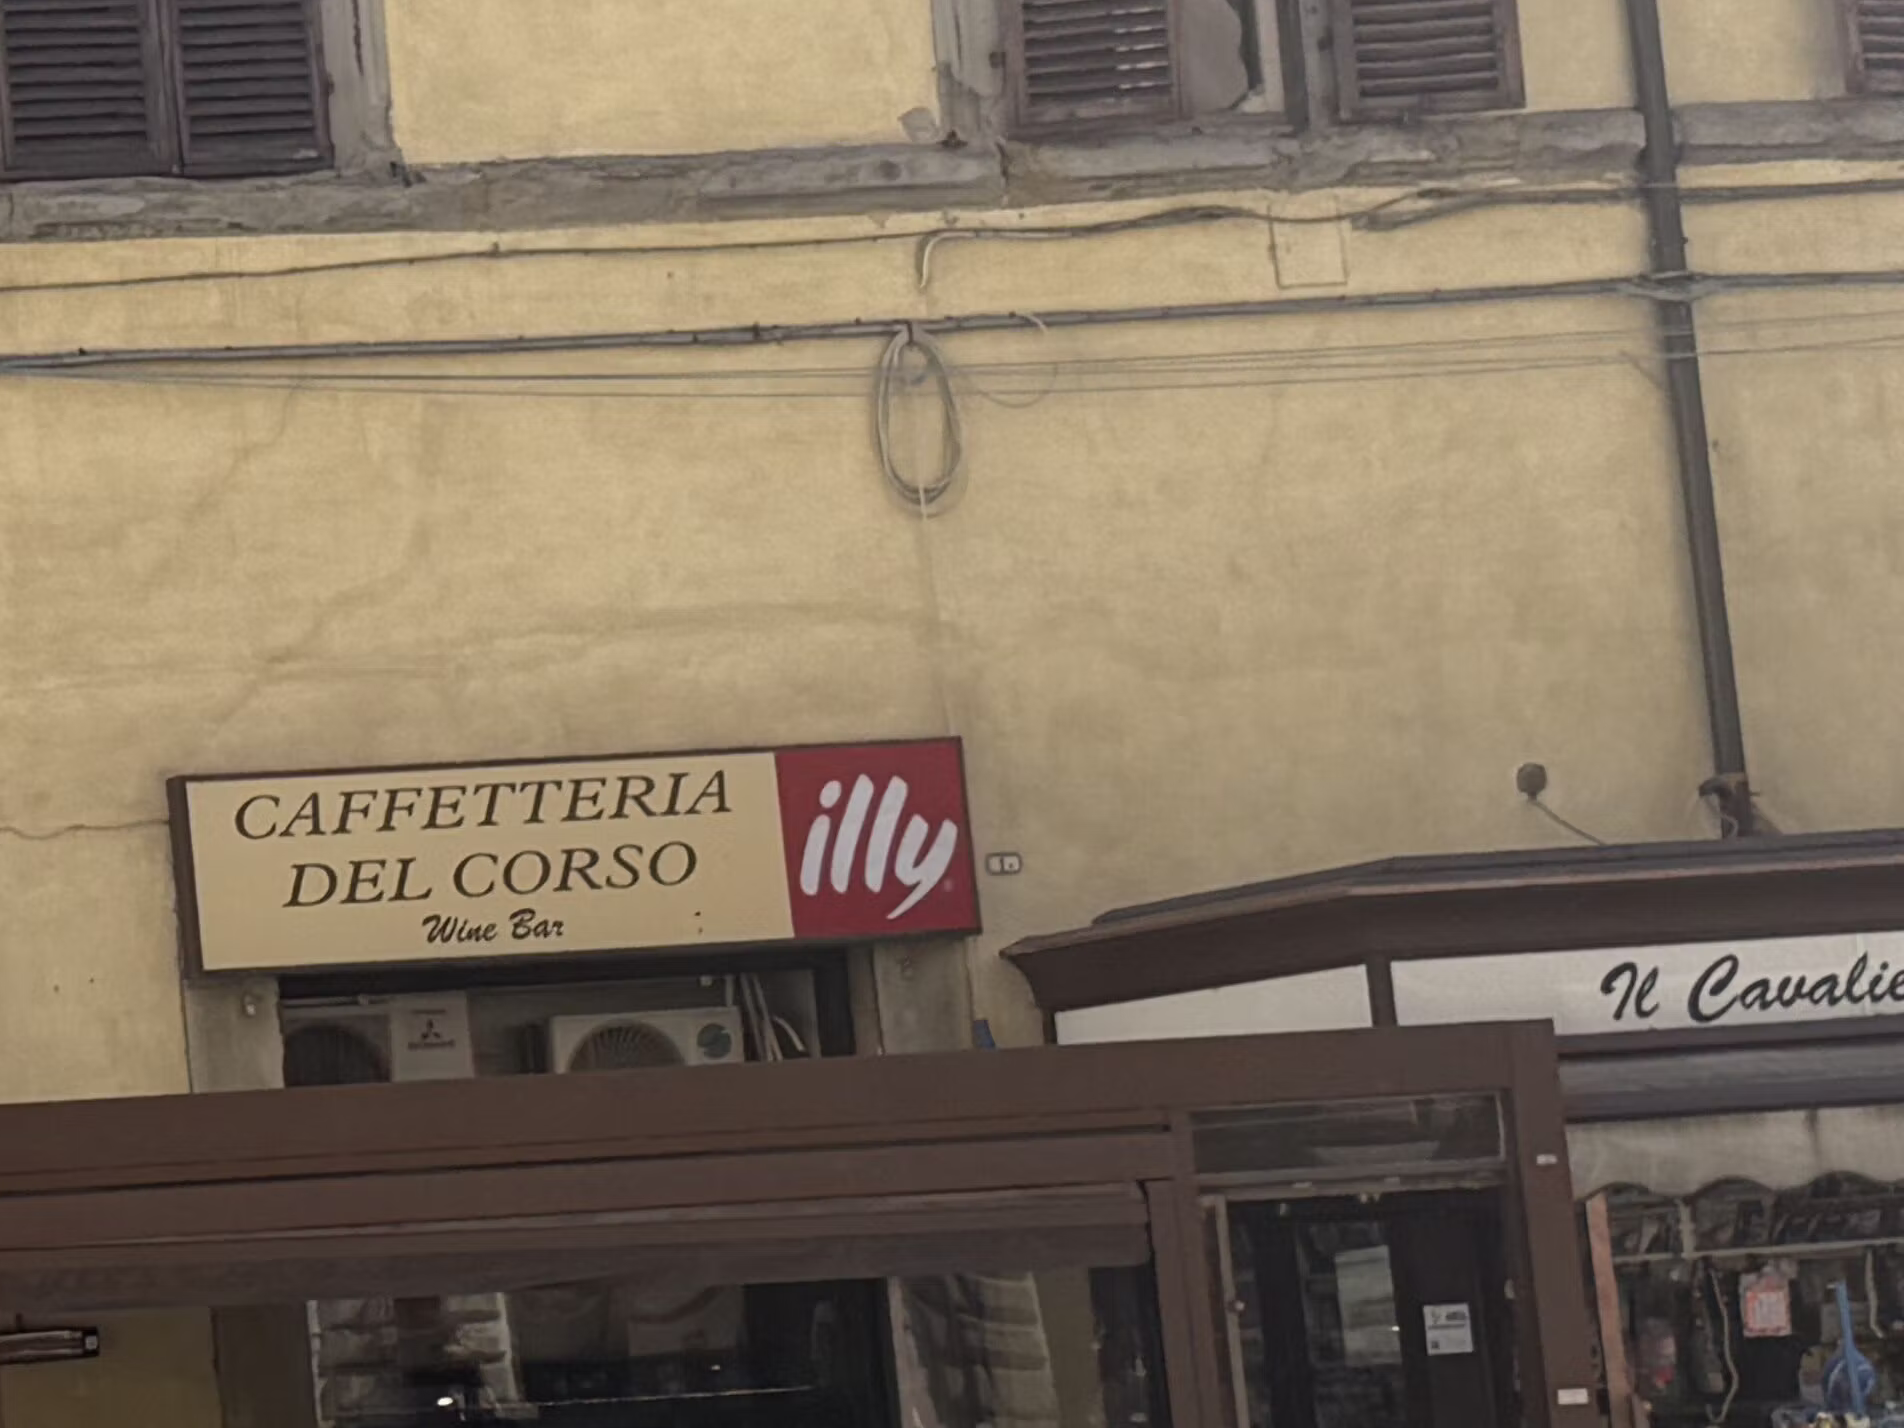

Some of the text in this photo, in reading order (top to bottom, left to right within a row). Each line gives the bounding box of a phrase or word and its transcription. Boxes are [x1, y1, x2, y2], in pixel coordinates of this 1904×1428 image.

[233, 767, 731, 840] CAFFETTERIA
[283, 839, 698, 908] DEL CORSO
[800, 774, 958, 919] illy
[421, 910, 564, 945] Wine Bar
[1600, 961, 1659, 1021] Il
